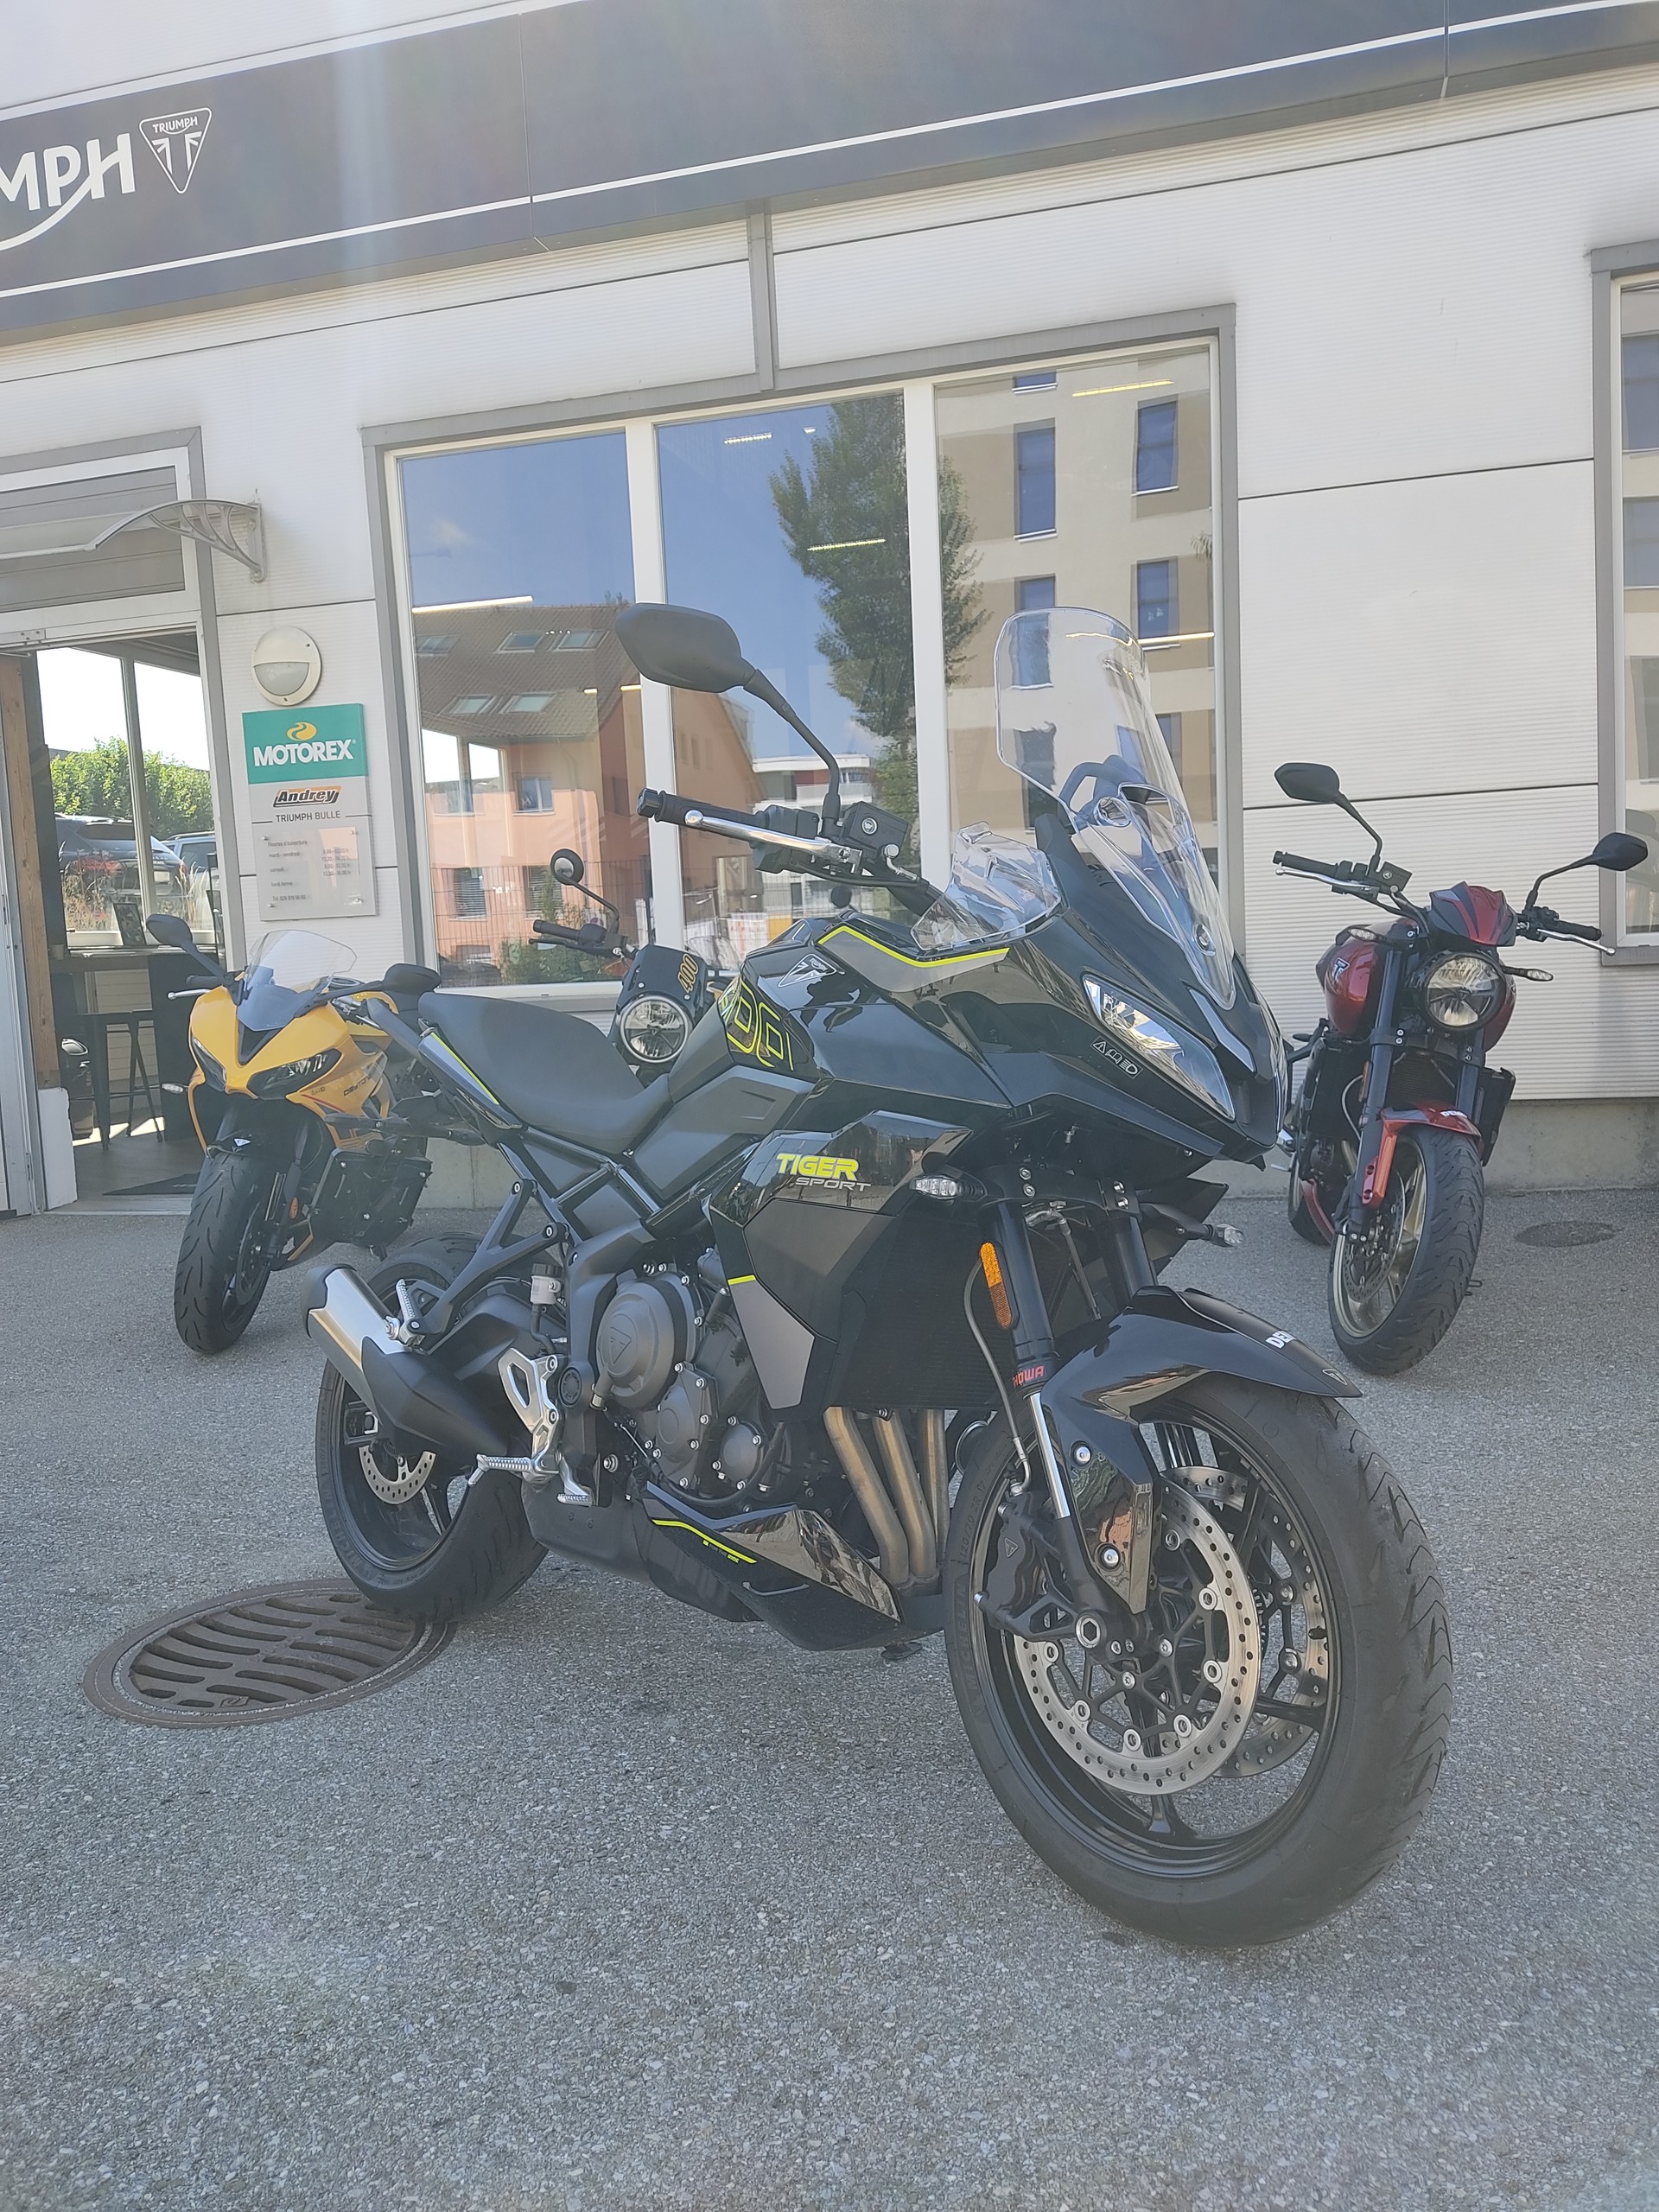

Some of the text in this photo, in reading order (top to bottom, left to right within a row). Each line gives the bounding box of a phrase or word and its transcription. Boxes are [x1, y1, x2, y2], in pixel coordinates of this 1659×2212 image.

[152, 116, 198, 135] TRIUMPH
[253, 739, 353, 767] MOTOREX
[276, 788, 338, 804] Andrey
[276, 810, 341, 823] TRIUMPH BULLE
[677, 953, 699, 994] 400
[777, 1153, 858, 1181] TIGER
[795, 1177, 872, 1192] SPORT
